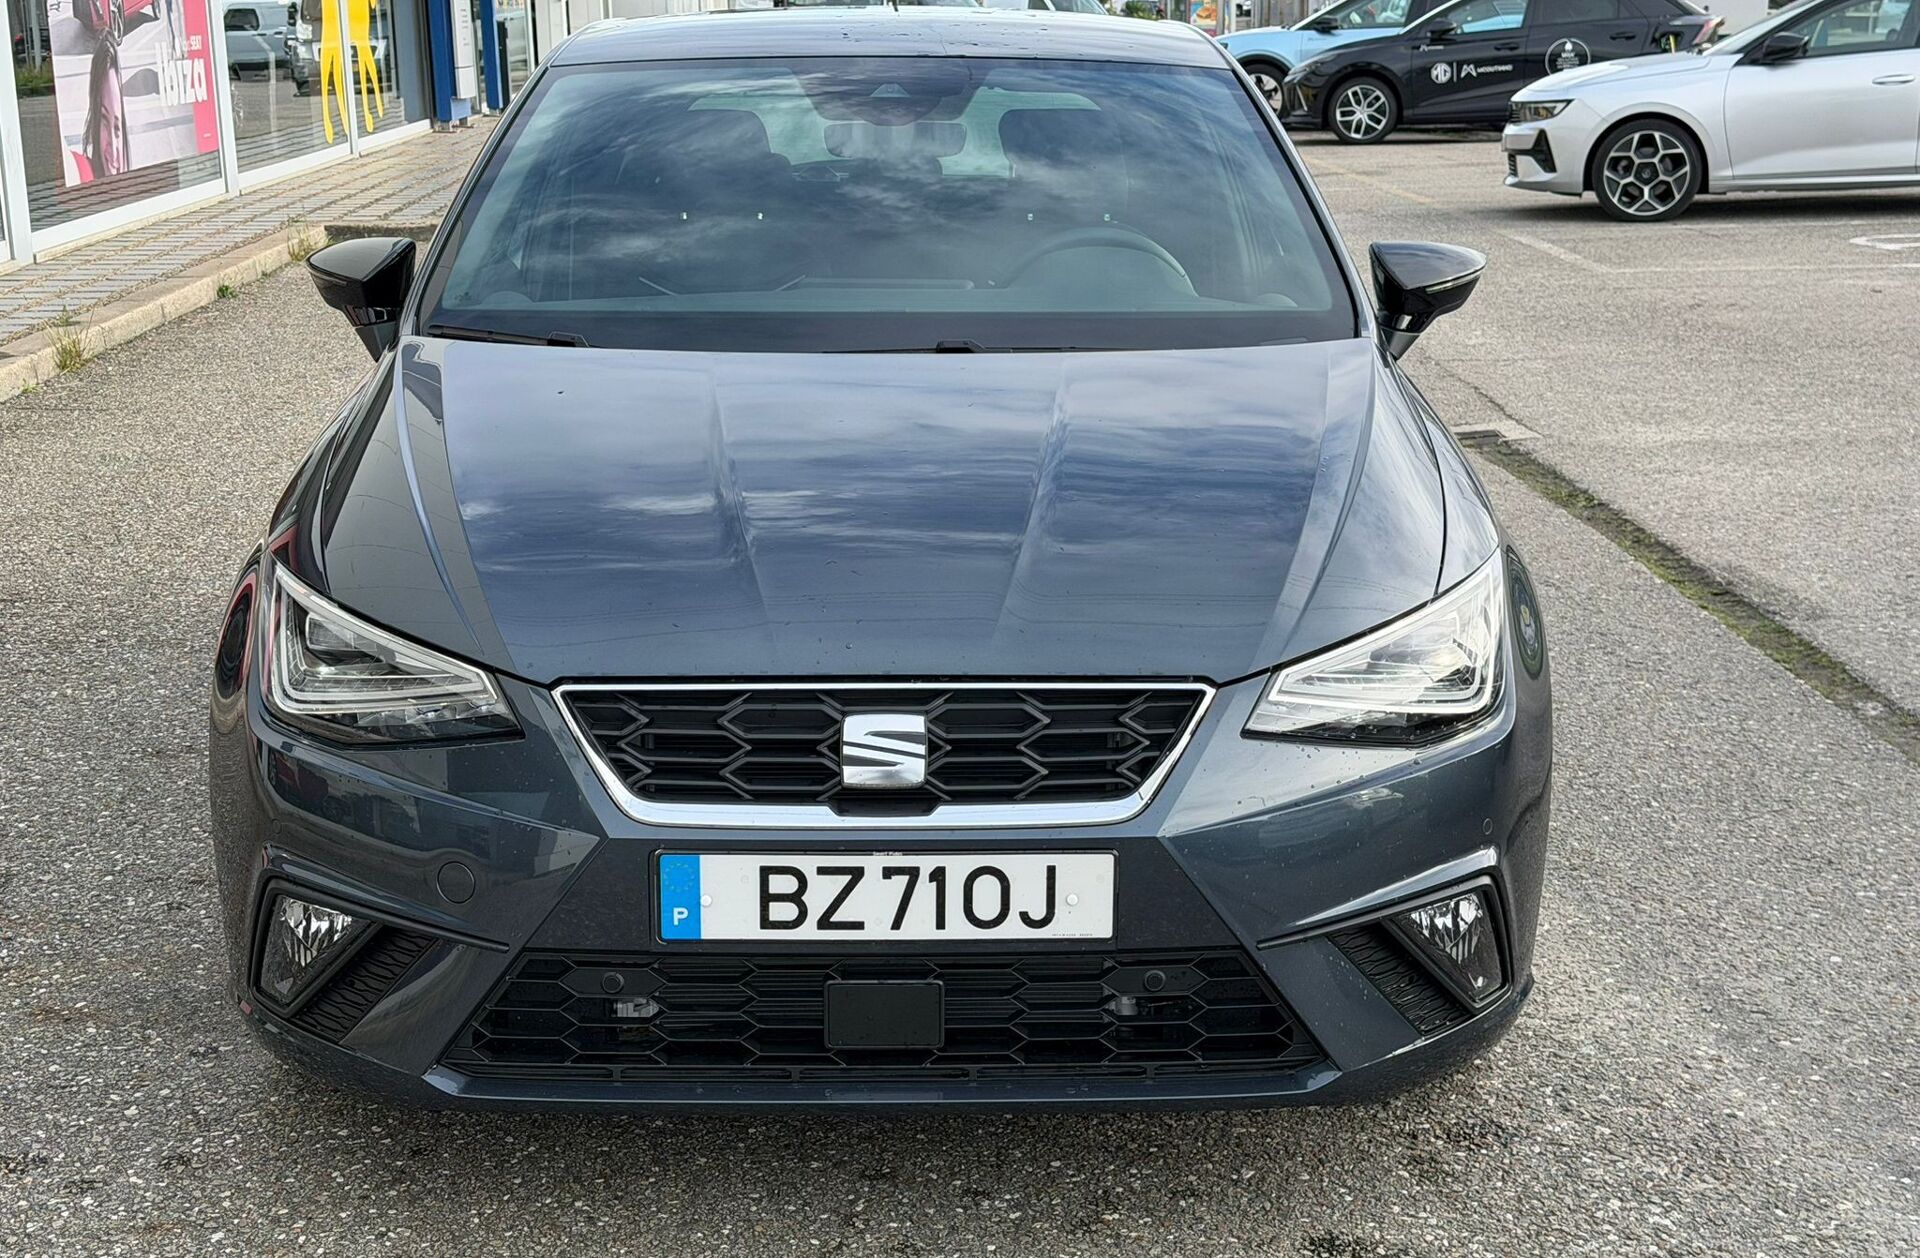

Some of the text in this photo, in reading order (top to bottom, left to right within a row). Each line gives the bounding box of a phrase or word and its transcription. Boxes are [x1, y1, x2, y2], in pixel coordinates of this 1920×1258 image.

[190, 34, 203, 51] SEAT
[155, 42, 208, 106] Ibiza
[1431, 63, 1452, 84] MG
[673, 907, 689, 926] P
